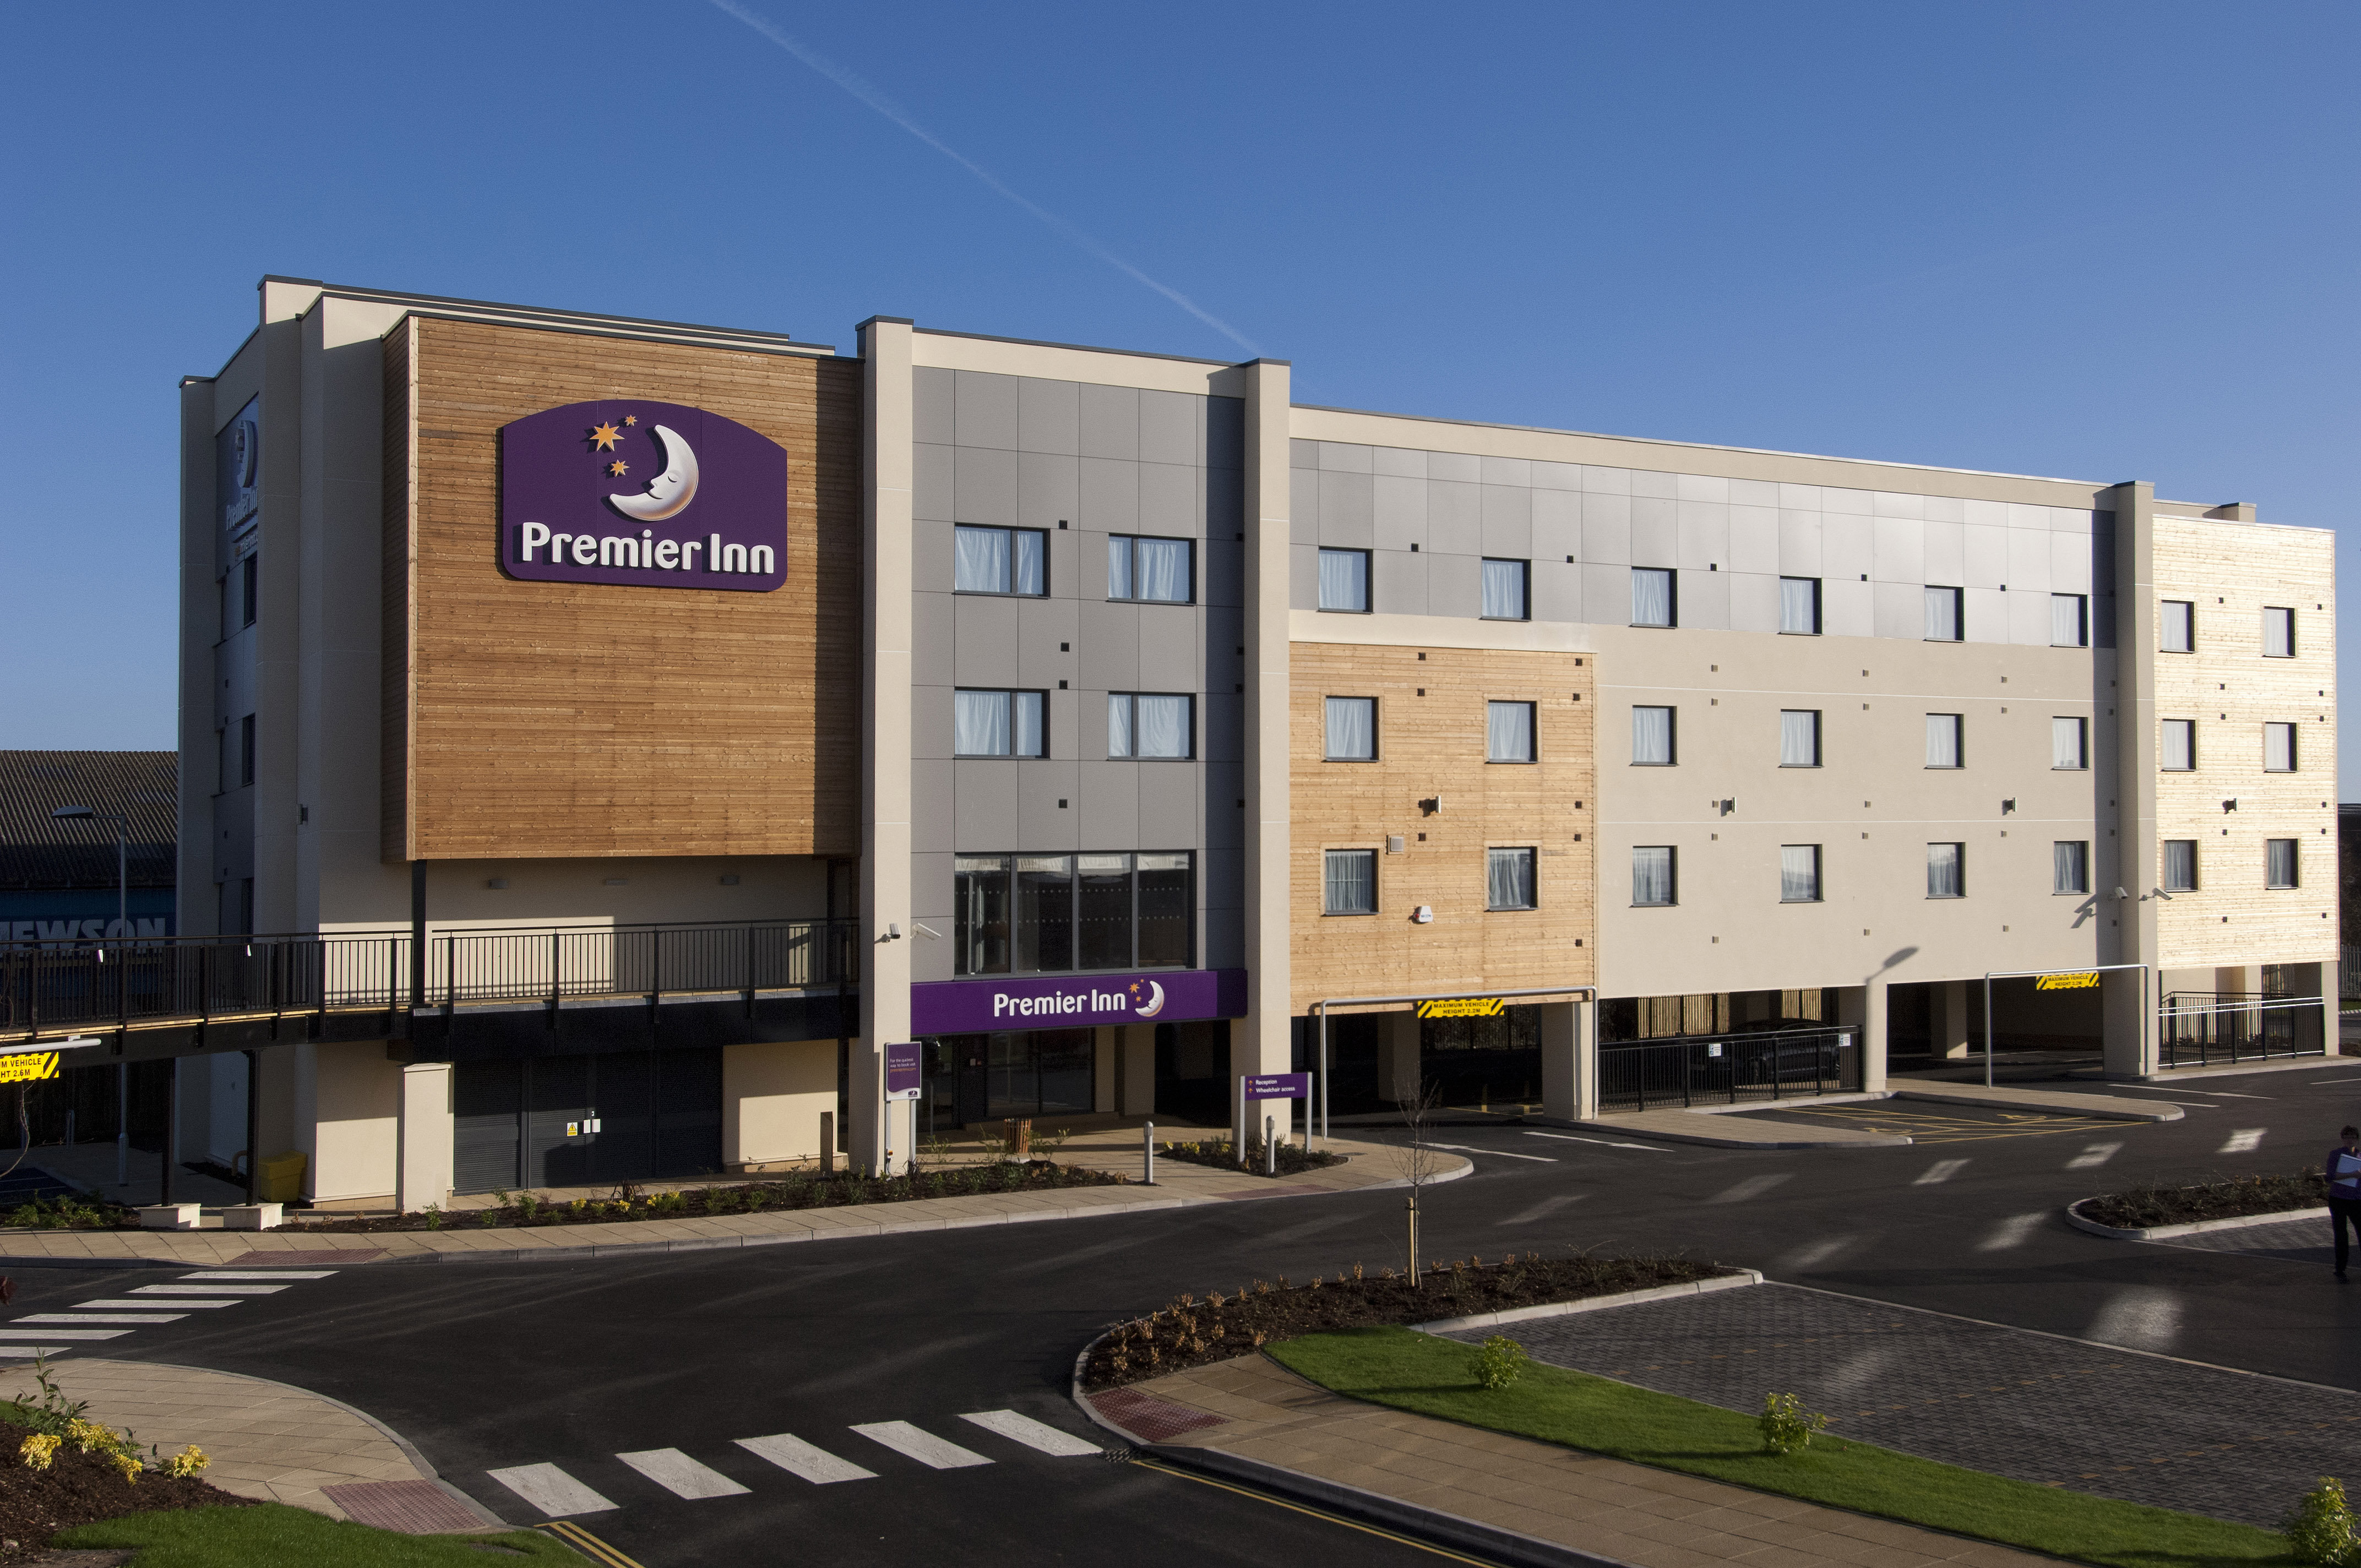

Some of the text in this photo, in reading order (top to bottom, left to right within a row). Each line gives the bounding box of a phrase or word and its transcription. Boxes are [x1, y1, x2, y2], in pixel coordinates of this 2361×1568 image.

[523, 521, 774, 574] Premier Inn
[994, 989, 1126, 1017] Premier Inn
[10, 1058, 41, 1068] VEHICLE
[13, 1069, 30, 1077] 2.6M
